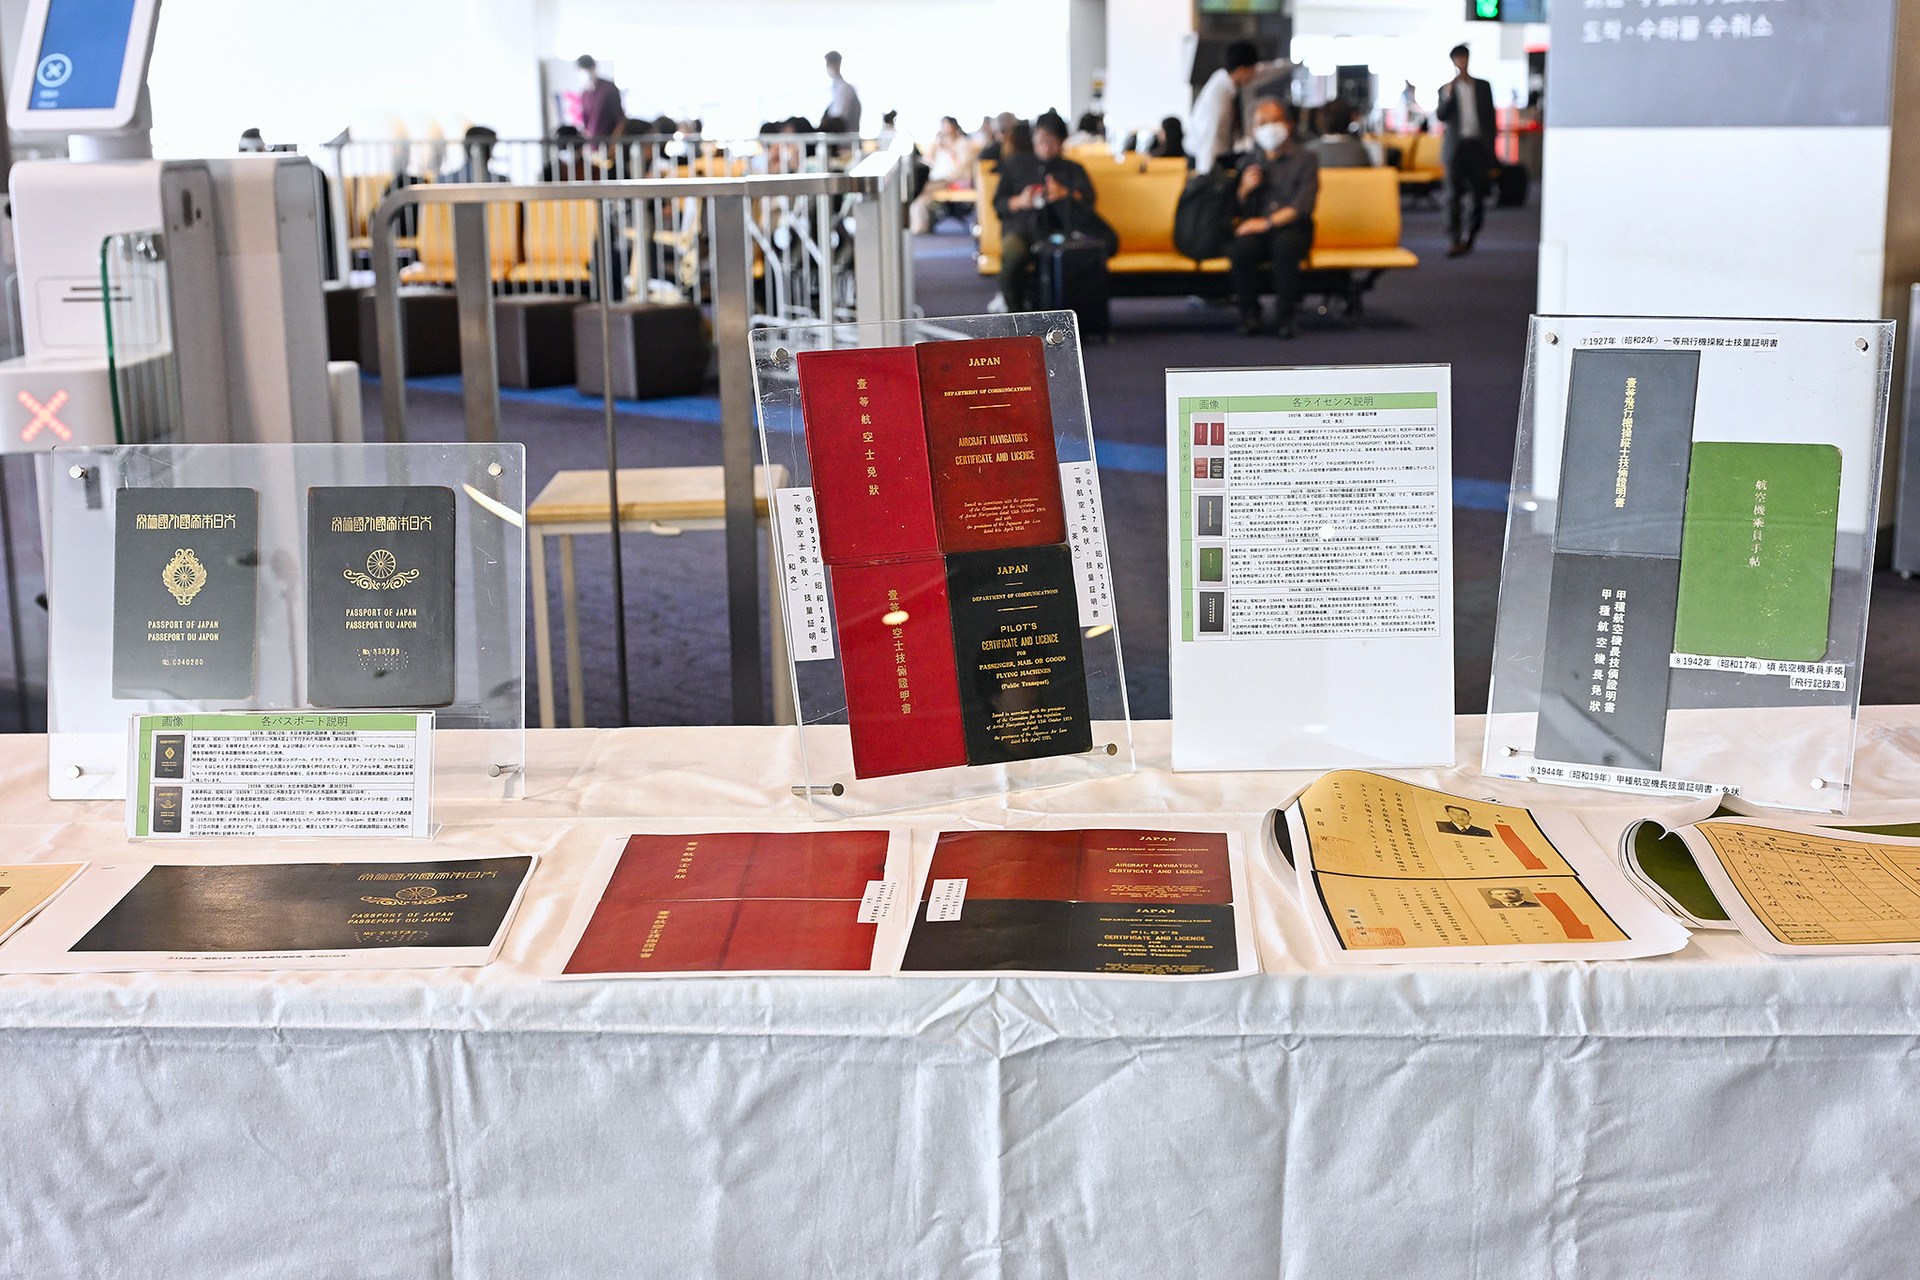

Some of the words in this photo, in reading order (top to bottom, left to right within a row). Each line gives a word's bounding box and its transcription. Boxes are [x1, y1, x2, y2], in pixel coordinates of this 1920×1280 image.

[969, 357, 1000, 367] JAPAN
[987, 386, 1032, 394] COMMUNICATIONS
[1199, 399, 1219, 410] 画像
[1293, 396, 1374, 408] 各ライセンス説明
[958, 436, 987, 447] AIRCRAFT
[989, 433, 1029, 445] NAVIGATOR'S
[955, 453, 993, 466] CERTIFICATE
[995, 452, 1009, 462] AND
[1010, 450, 1035, 461] LICENCE
[997, 564, 1029, 575] JAPAN
[972, 594, 1006, 602] DEPARTMENT
[1015, 588, 1059, 598] COMMUNICATIONS
[346, 608, 381, 617] PASSPORT
[384, 608, 393, 616] OF
[395, 608, 417, 616] JAPAN
[148, 620, 183, 629] PASSPORT
[186, 620, 195, 629] OF
[198, 620, 219, 629] JAPAN
[345, 621, 383, 629] PASSEPORT
[385, 621, 395, 629] DU
[396, 621, 417, 629] JAPON
[1000, 622, 1038, 633] PILOT'S
[148, 632, 186, 641] PASSEPORT
[187, 632, 196, 641] DU
[198, 632, 219, 641] JAPON
[981, 637, 1019, 651] CERTIFICATE
[1020, 636, 1033, 646] AND
[1035, 633, 1059, 645] LICENCE
[979, 661, 1016, 671] PASSENGER,
[1017, 659, 1033, 667] MAIL
[1045, 655, 1066, 663] GOODS
[996, 671, 1019, 679] FLYING
[1020, 668, 1051, 677] MACHINES
[1001, 682, 1020, 691] (Public
[1021, 679, 1050, 687] Transport)
[162, 716, 184, 727] 画像
[262, 716, 348, 727] 各パスポート説明
